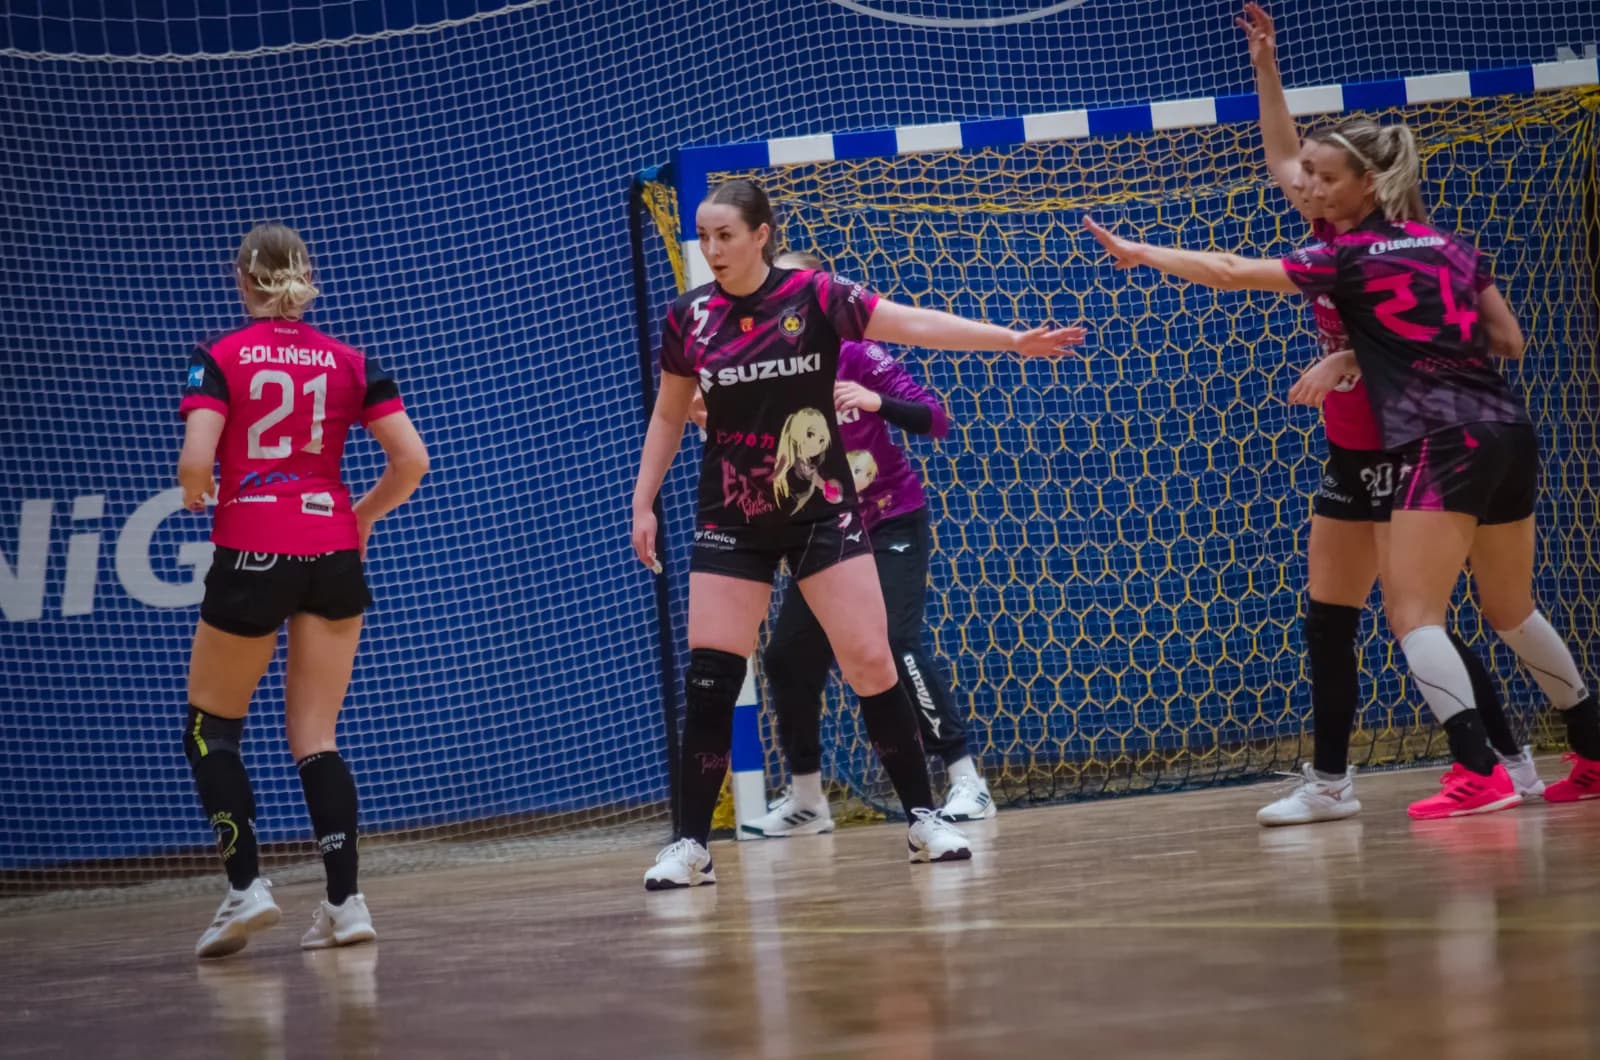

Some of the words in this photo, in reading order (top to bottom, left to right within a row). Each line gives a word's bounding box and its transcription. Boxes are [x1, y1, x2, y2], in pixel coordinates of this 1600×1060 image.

[1363, 266, 1478, 342] 24
[239, 343, 337, 369] SOLIŃSKA
[718, 353, 821, 387] SUZUKI
[247, 369, 328, 460] 21
[703, 530, 737, 545] Kielce
